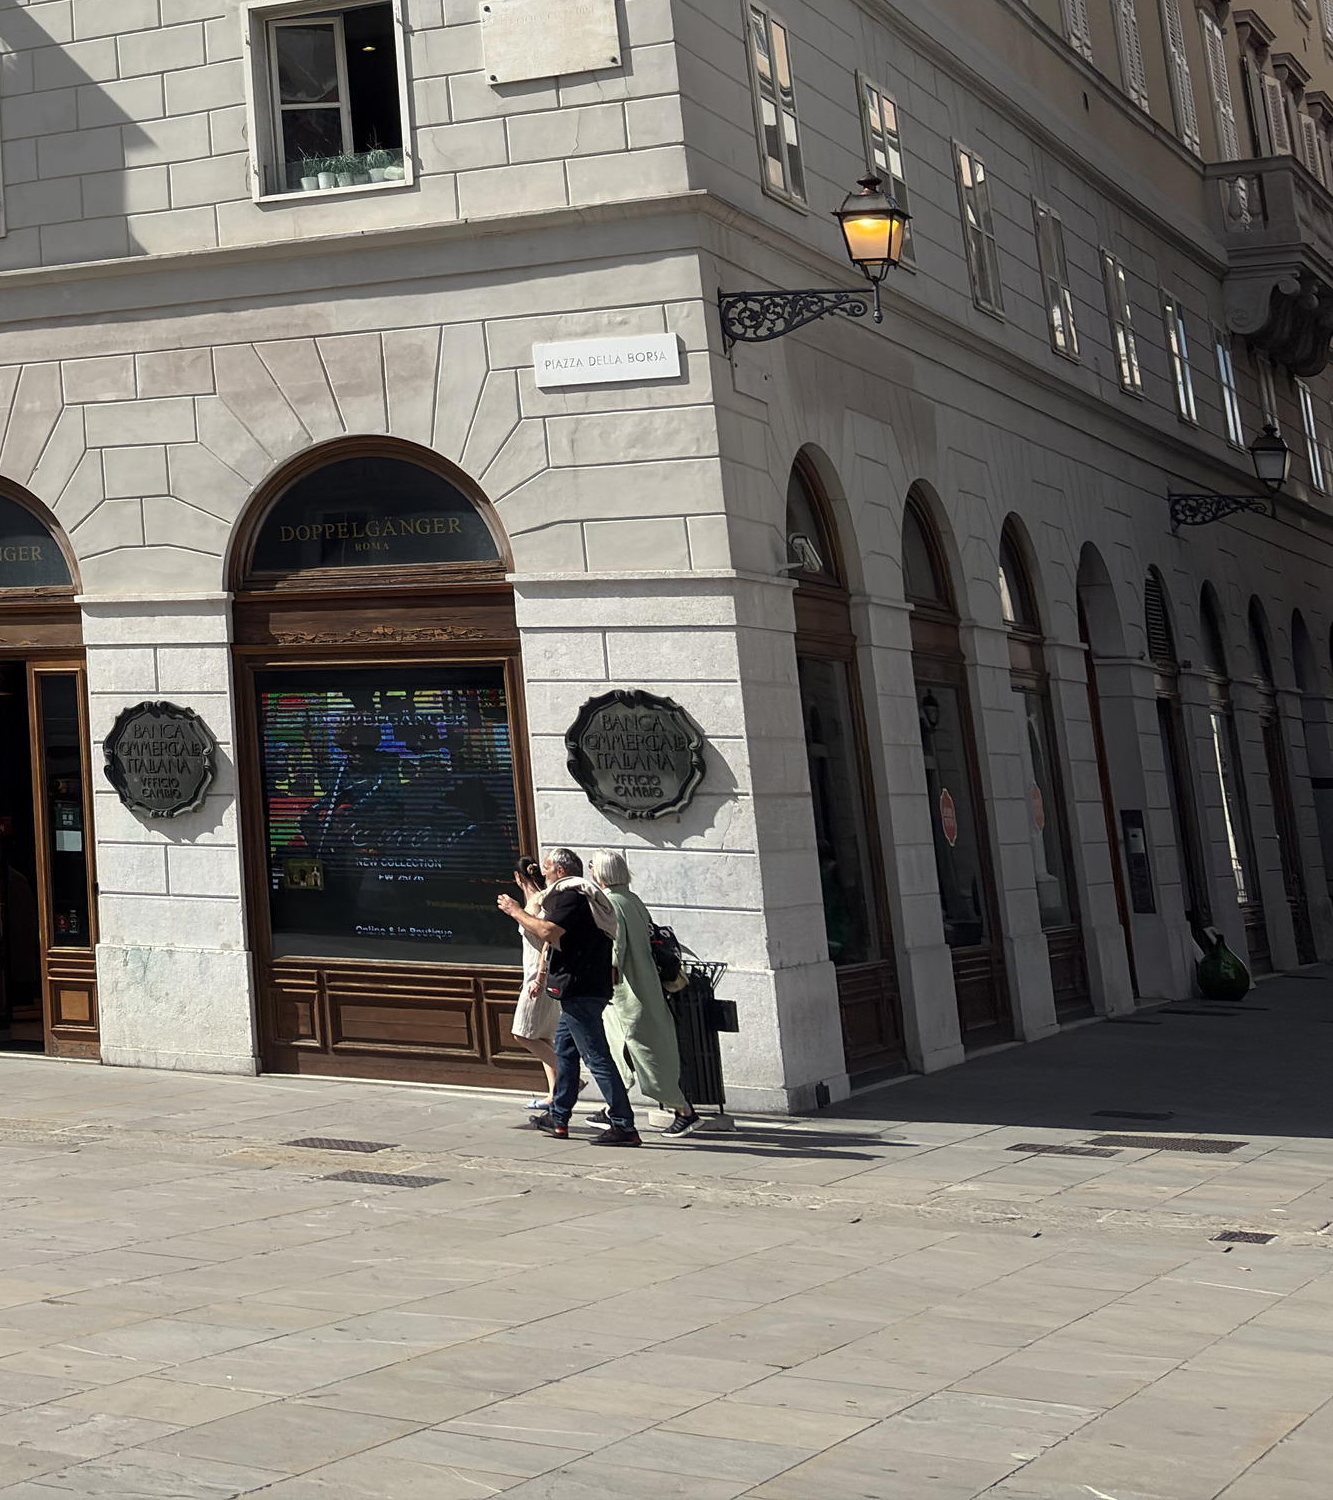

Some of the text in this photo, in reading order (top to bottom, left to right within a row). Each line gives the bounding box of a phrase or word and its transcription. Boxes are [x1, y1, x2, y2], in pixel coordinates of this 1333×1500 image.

[544, 351, 667, 370] PIAZZA DELLA BORSA
[280, 516, 463, 542] DOPPELGÄNGER
[355, 542, 390, 552] ROMA
[602, 714, 665, 732] BANCA
[134, 724, 185, 739] BANCA
[142, 788, 182, 799] CAMBIO
[614, 785, 664, 798] CAMBIO
[356, 857, 443, 869] NEW COLLECTION
